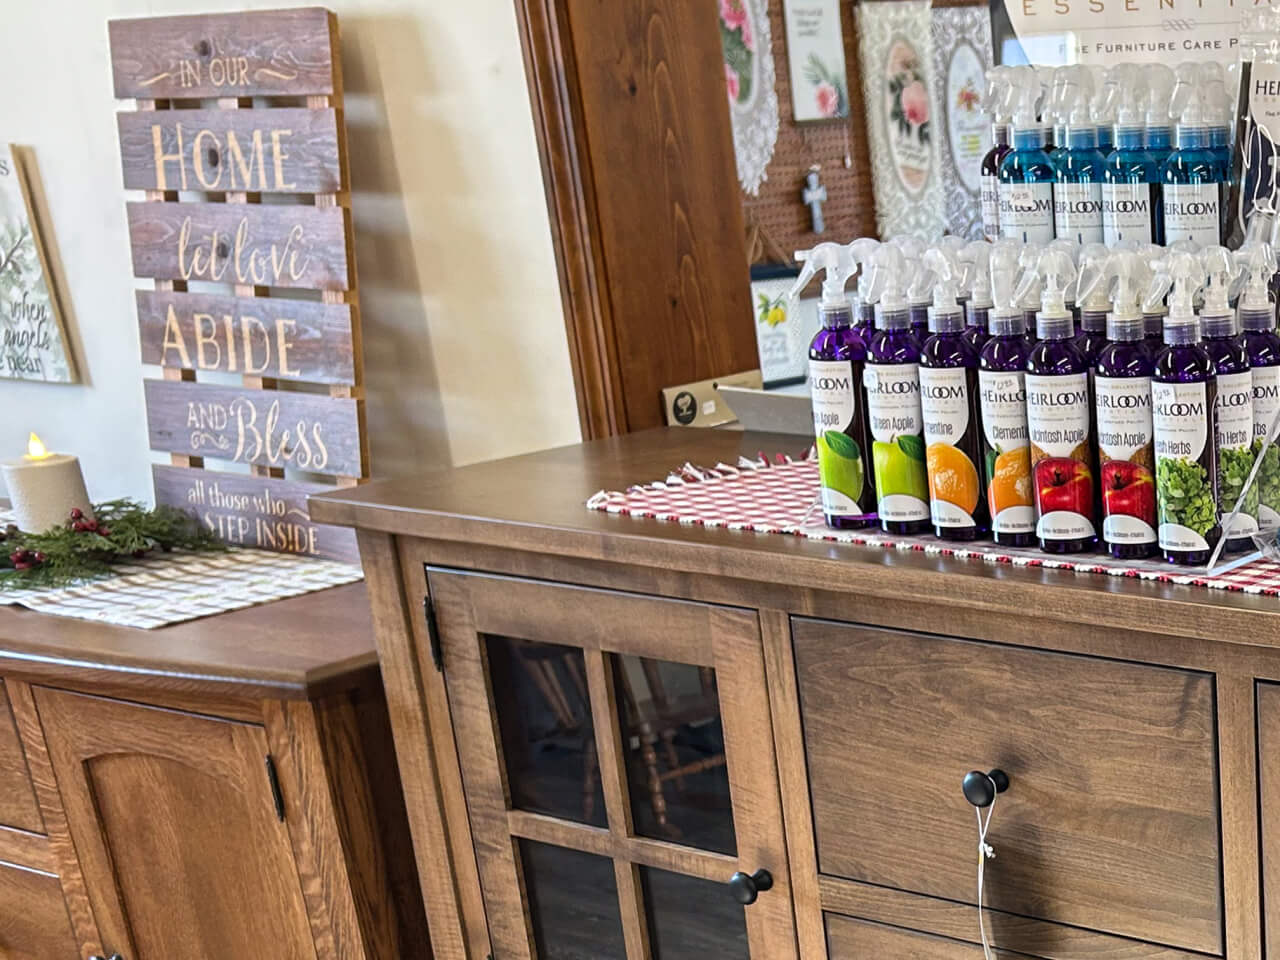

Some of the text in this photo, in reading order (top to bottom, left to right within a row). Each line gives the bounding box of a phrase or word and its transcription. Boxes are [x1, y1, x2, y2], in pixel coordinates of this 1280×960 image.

[1096, 42, 1175, 53] FURNITURE
[1183, 39, 1222, 51] CARE
[180, 56, 250, 88] IN OUR
[150, 121, 297, 192] HOME
[179, 215, 311, 283] let love
[10, 291, 48, 322] when
[4, 319, 51, 351] angels
[161, 303, 301, 377] ABIDE
[187, 396, 329, 470] AND Bless
[891, 415, 915, 432] Apple
[1064, 428, 1085, 444] Apple
[1124, 431, 1147, 448] Apple
[1226, 429, 1248, 444] Herbs
[1168, 441, 1192, 455] Herbs
[187, 479, 287, 517] all those who
[204, 511, 320, 555] STEP INSIDE
